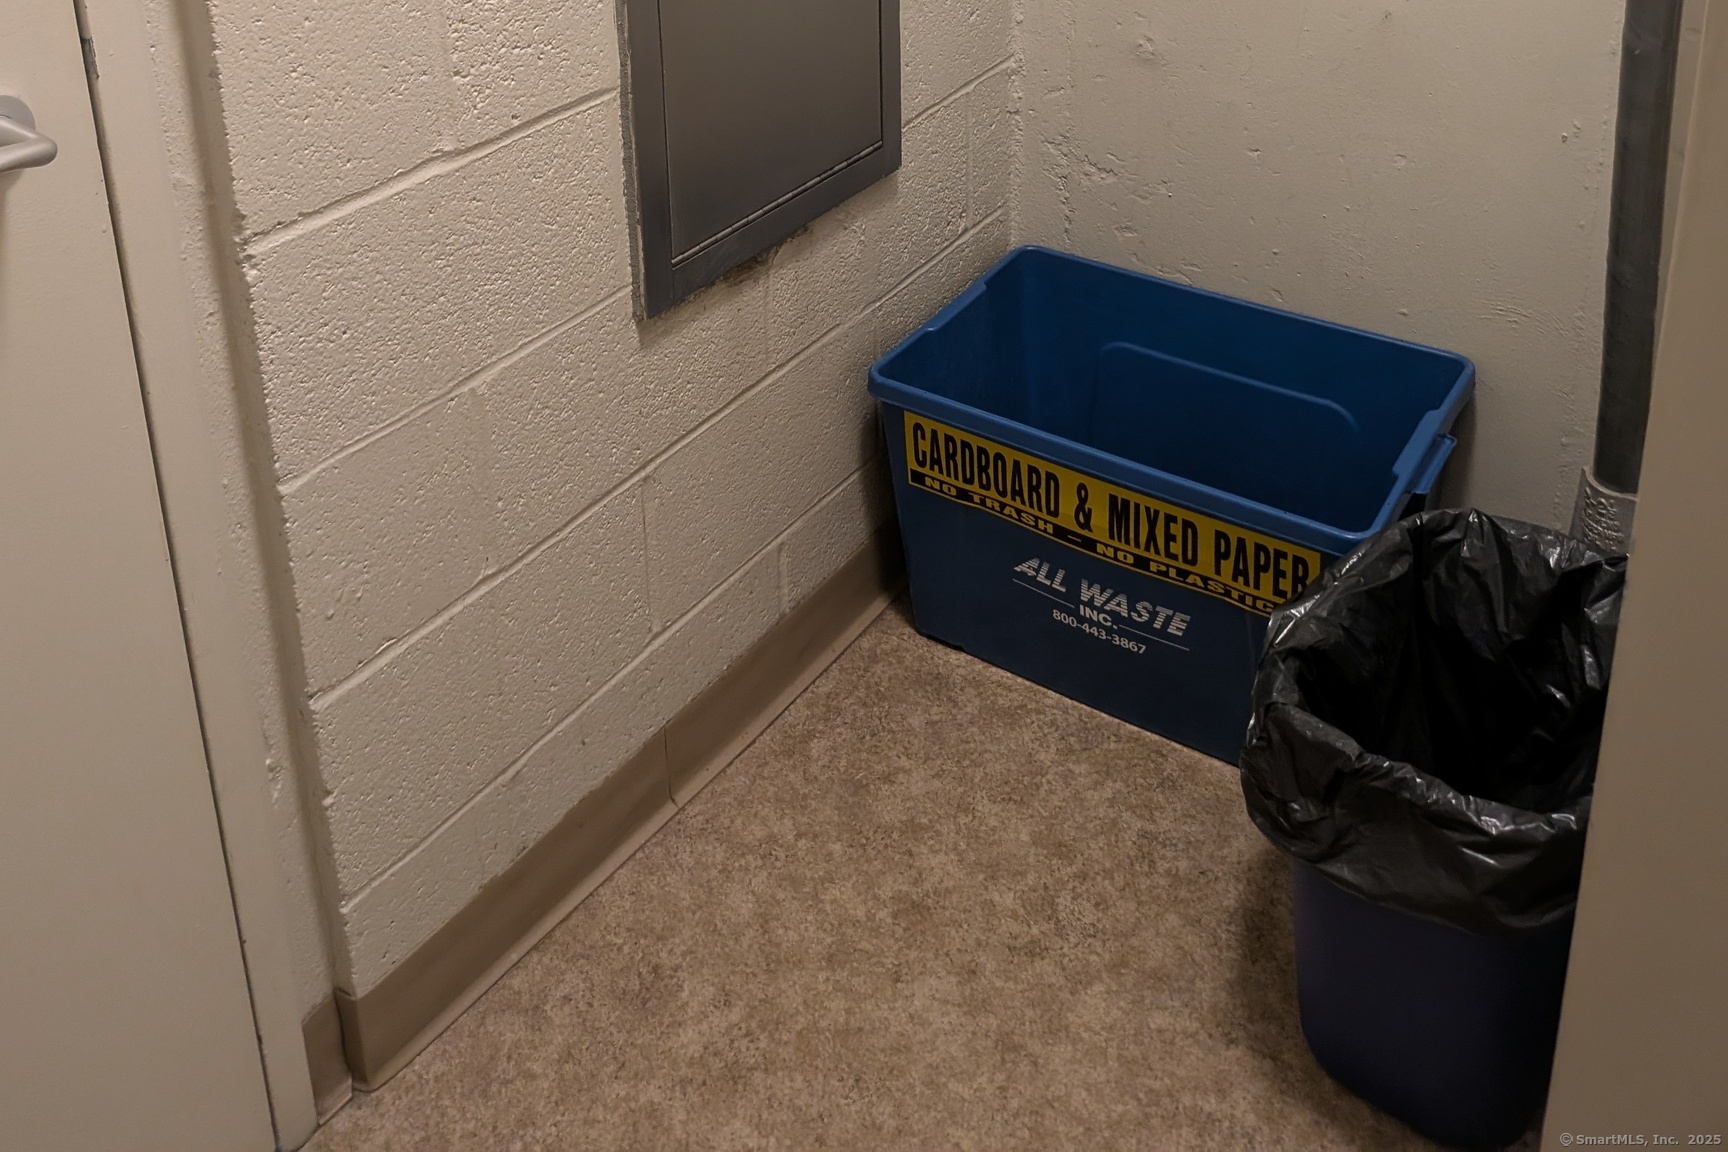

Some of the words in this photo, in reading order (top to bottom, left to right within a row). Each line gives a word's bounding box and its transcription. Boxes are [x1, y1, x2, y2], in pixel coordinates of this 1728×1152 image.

[912, 421, 1060, 519] CARDBOARD
[1074, 482, 1093, 533] &
[1108, 492, 1199, 567] MIXED
[1213, 529, 1310, 601] PAPER
[924, 476, 957, 497] NO
[968, 491, 1054, 535] TRASH
[1096, 542, 1135, 564] NO
[1013, 557, 1067, 593] ALL
[1080, 577, 1191, 637] WASTE
[1052, 608, 1147, 655] 800-443-3867
[1079, 604, 1118, 630] INC.
